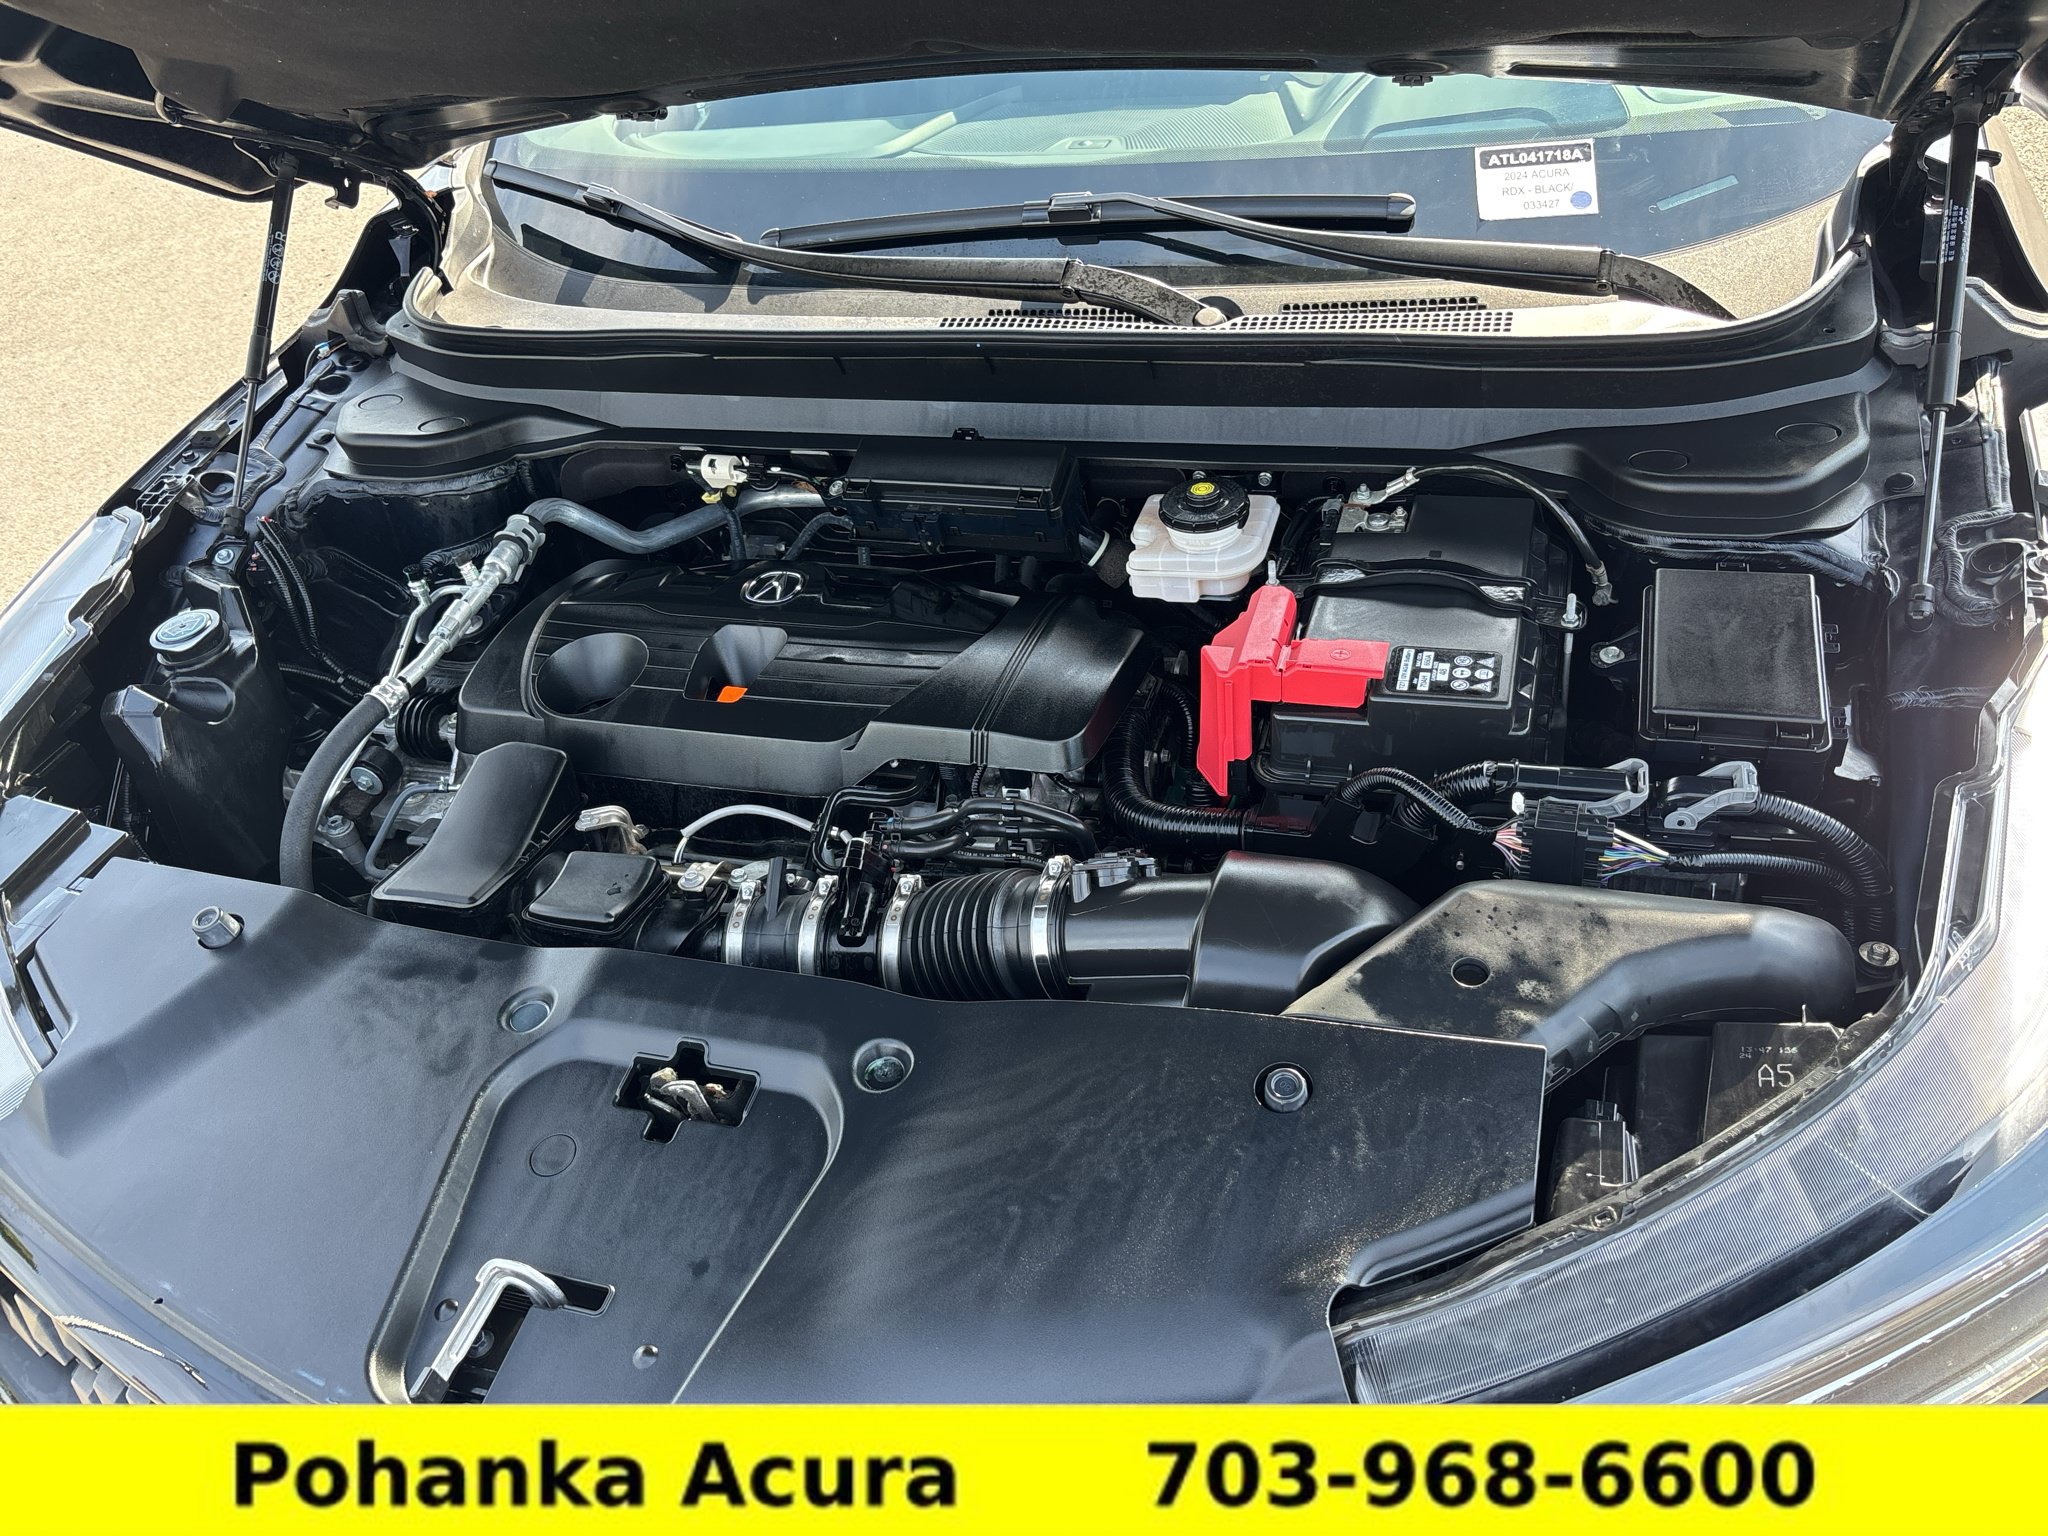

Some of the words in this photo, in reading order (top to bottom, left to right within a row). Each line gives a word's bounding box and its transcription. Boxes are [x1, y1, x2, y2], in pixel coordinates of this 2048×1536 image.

[1488, 149, 1584, 167] ATL041718A
[1504, 170, 1528, 181] 2024
[1531, 168, 1570, 178] ACURA
[1502, 186, 1525, 197] RDX
[1523, 199, 1560, 210] 033427
[1758, 1063, 1795, 1088] A5
